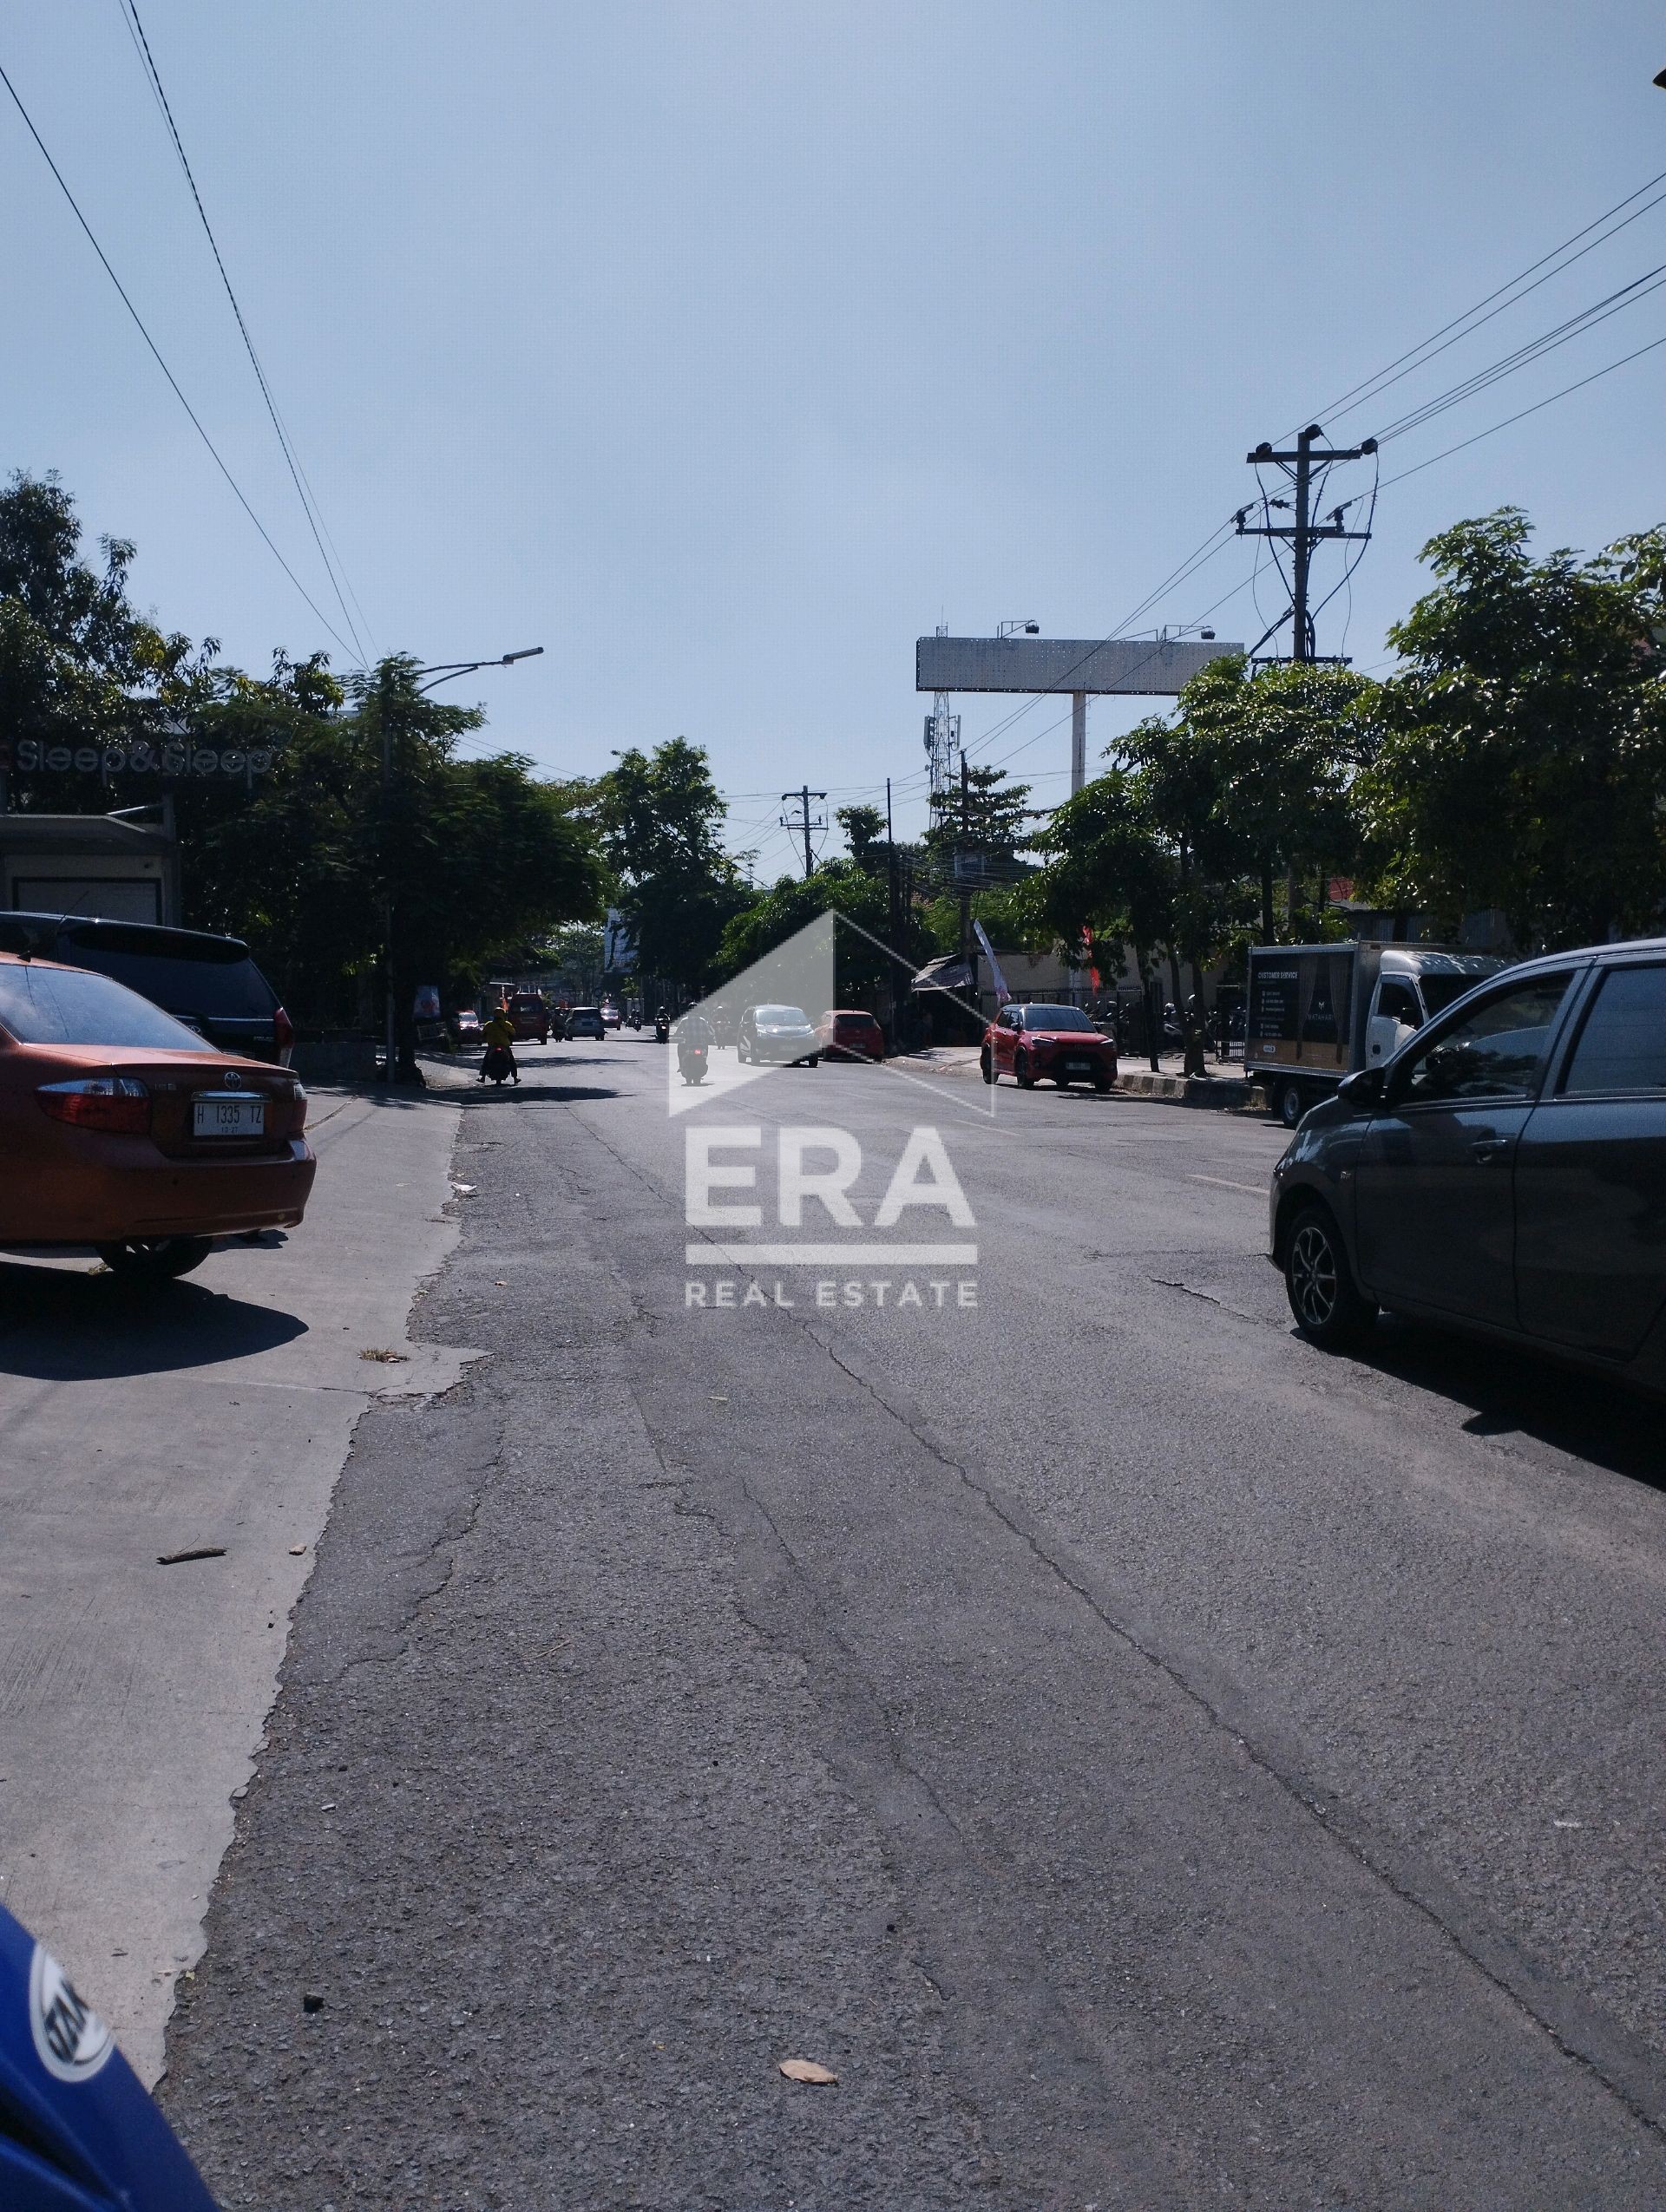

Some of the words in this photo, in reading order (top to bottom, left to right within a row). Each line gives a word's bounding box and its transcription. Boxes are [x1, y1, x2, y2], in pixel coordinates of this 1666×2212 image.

[16, 740, 272, 789] Sleep&Sleep
[197, 1106, 204, 1124] H
[216, 1105, 240, 1124] 1335
[250, 1106, 262, 1124] TZ
